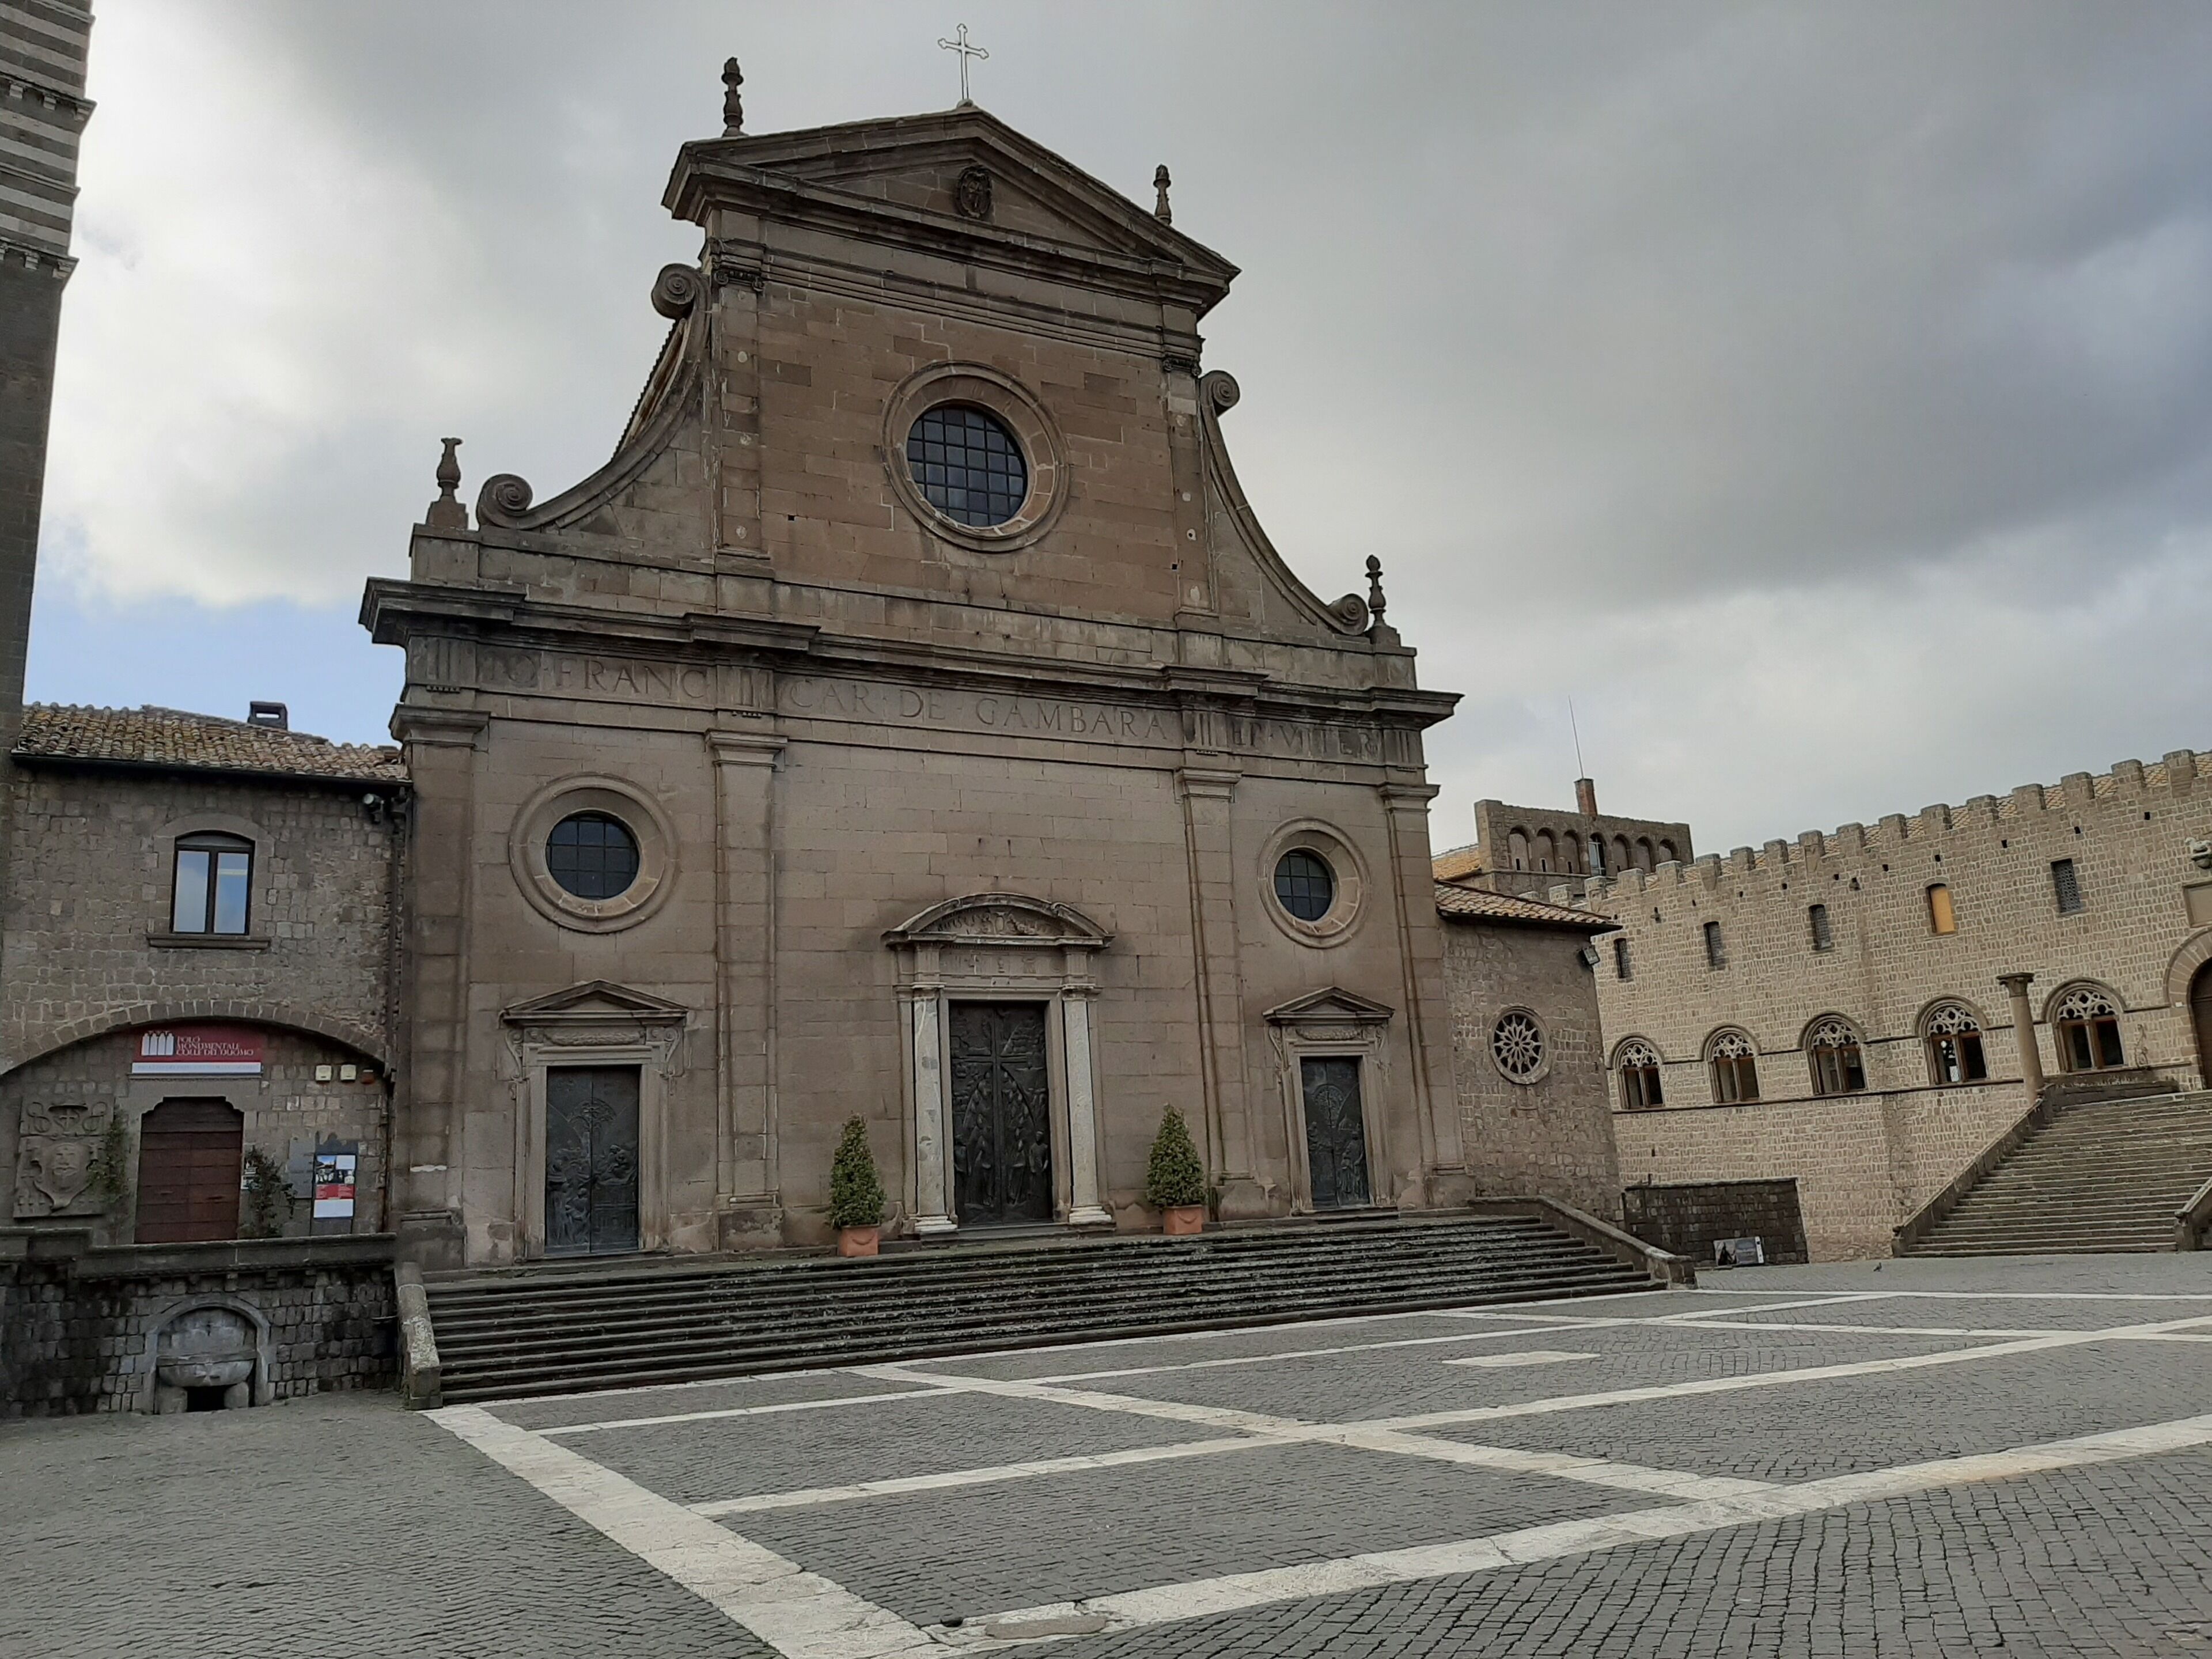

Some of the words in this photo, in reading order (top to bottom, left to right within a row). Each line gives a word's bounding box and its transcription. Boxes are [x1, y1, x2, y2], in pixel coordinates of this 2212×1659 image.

[554, 657, 707, 699] FRANC
[790, 678, 876, 715] CAR
[899, 689, 946, 720] DE
[976, 698, 1167, 740] GAMBARA
